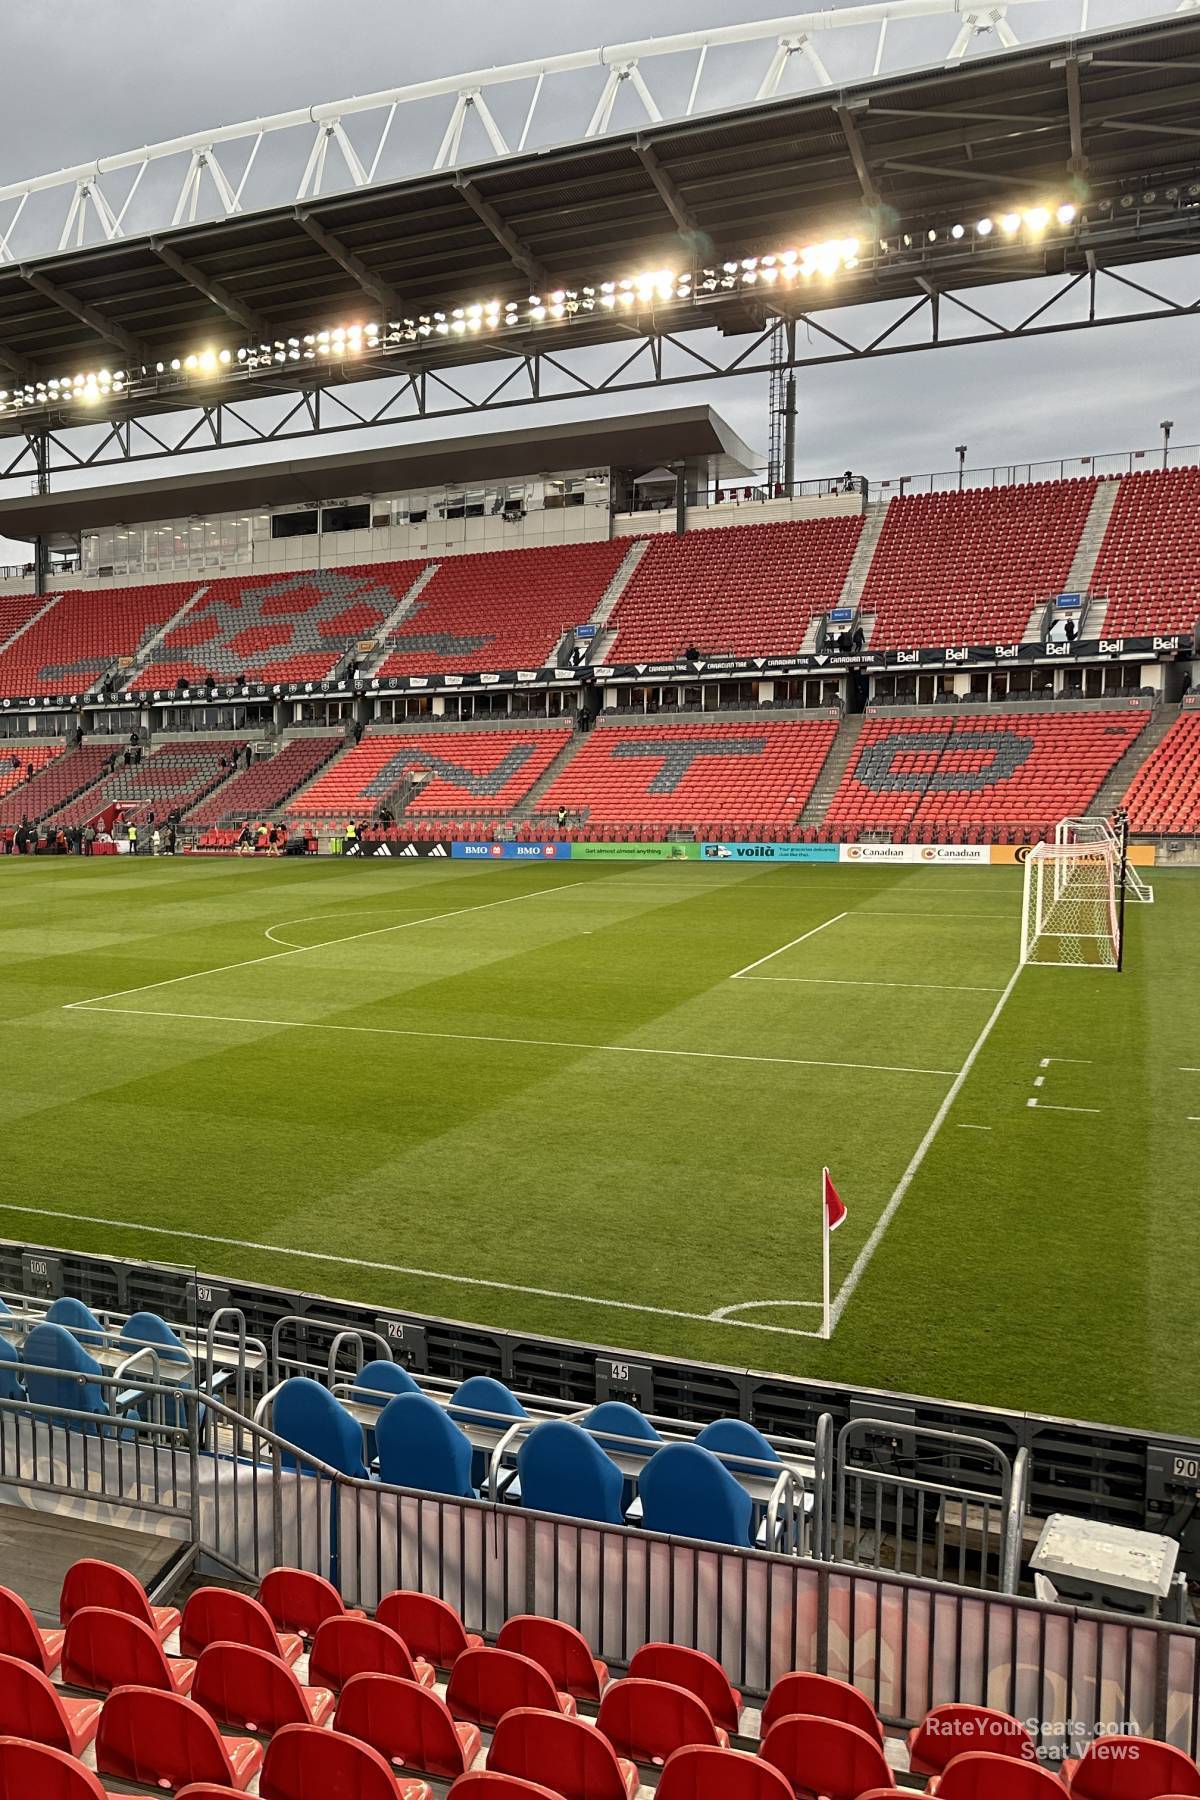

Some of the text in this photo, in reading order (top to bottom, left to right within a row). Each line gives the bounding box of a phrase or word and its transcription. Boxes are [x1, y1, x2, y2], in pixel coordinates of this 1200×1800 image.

[1046, 643, 1070, 655] Bell
[1099, 639, 1124, 653] Bell
[1153, 637, 1179, 650] Bell
[897, 651, 919, 663] Bell
[945, 648, 968, 661] Bell
[995, 645, 1018, 658] Bell
[861, 655, 875, 663] TIRE
[465, 846, 488, 854] BMO
[517, 846, 540, 855] BMO
[737, 844, 775, 857] voilà
[862, 848, 904, 857] Canadian
[937, 849, 980, 858] Canadian
[31, 1260, 47, 1274] 100
[198, 1287, 211, 1301] 37
[389, 1323, 403, 1338] 26
[612, 1364, 628, 1380] 45
[1175, 1458, 1197, 1477] 90
